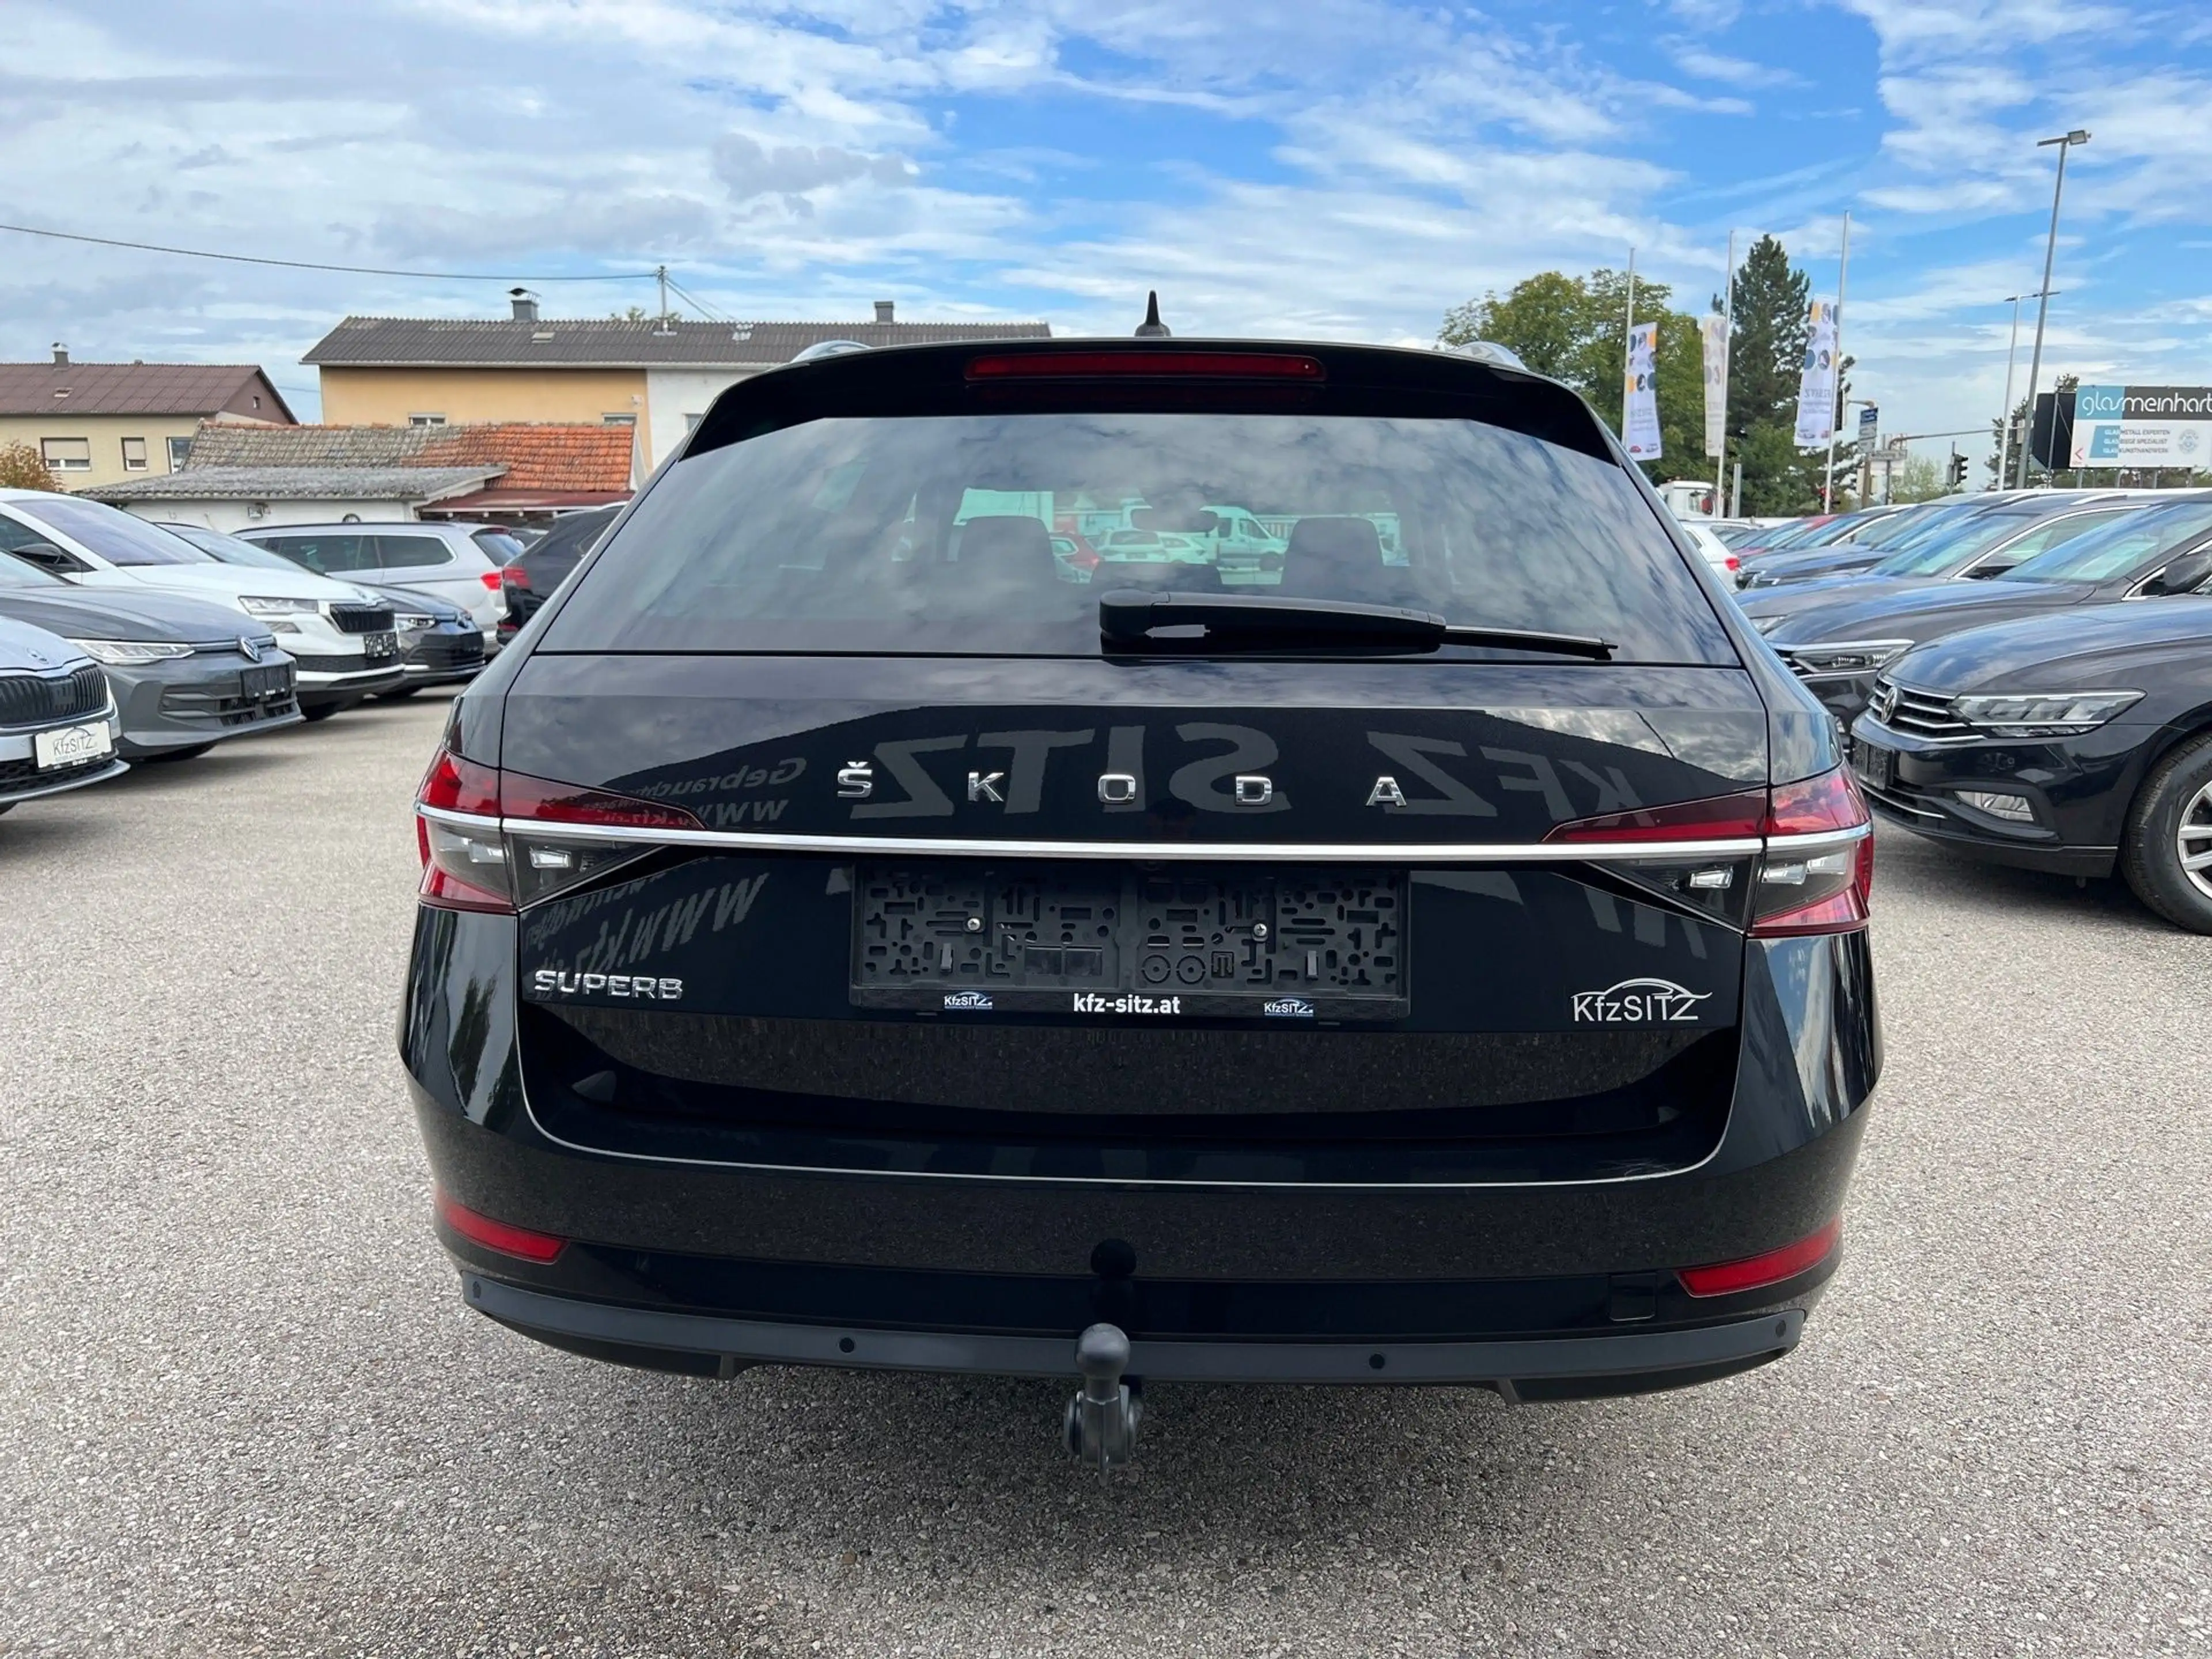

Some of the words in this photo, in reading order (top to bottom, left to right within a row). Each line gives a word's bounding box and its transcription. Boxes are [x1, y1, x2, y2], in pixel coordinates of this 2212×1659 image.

[837, 761, 1407, 807] ŠKODA
[534, 970, 683, 1000] SUPERB
[944, 995, 987, 1006] KfzSITZ
[1073, 993, 1181, 1014] kfz-sitz.at
[1264, 1002, 1308, 1013] KfzSITZ
[1573, 994, 1699, 1022] KfzSITZ
